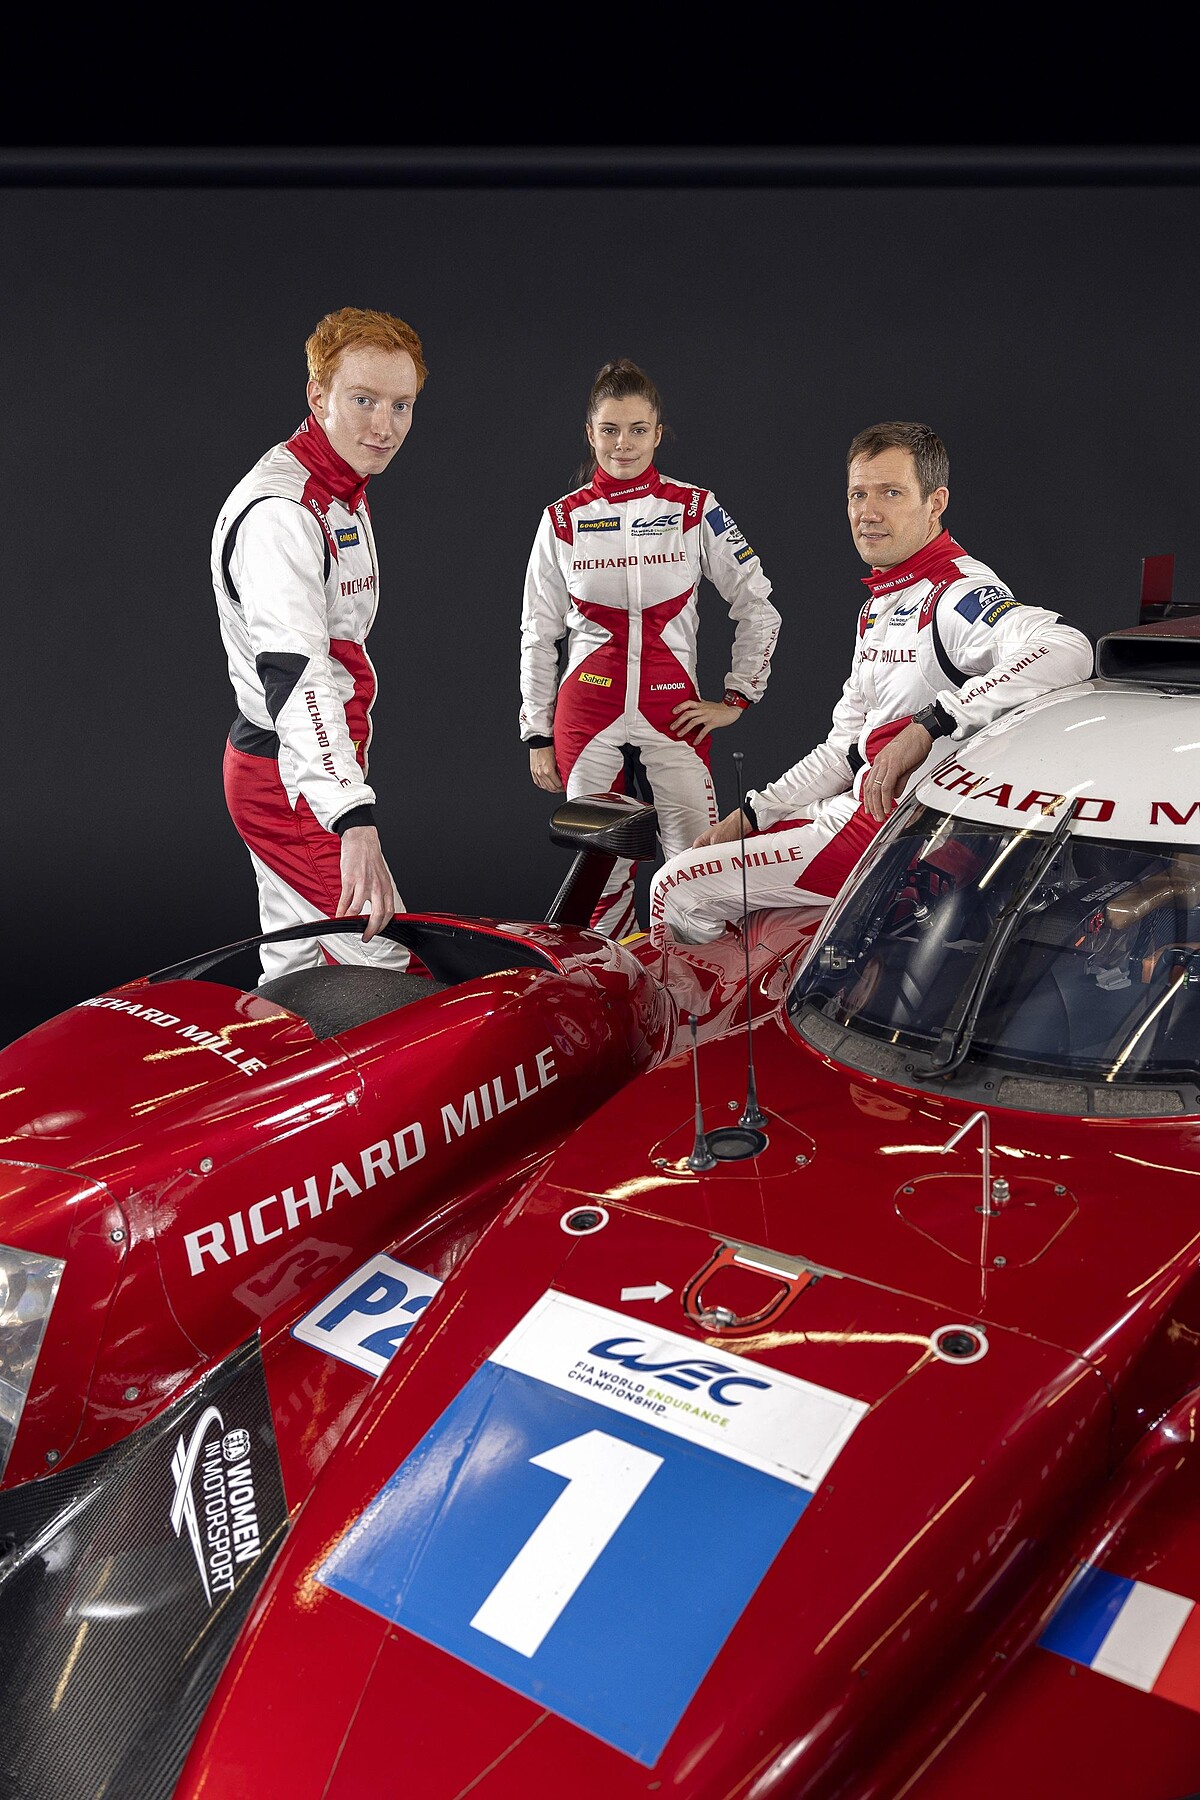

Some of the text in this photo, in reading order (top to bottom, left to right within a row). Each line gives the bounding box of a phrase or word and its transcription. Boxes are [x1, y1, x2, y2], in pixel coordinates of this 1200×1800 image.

[554, 503, 568, 529] Sabelt
[579, 521, 618, 529] GOODYEAR
[631, 513, 682, 528] WEC
[688, 490, 701, 518] Sabelt
[573, 551, 686, 571] RICHARD MILLE
[895, 573, 914, 585] MILLE
[582, 673, 609, 685] Sabelt
[1010, 646, 1050, 675] MILLE
[650, 681, 686, 691] L.WADOUX
[304, 690, 331, 748] RICHARD
[651, 846, 804, 921] RICHARD MILLE
[175, 1024, 268, 1077] MILLE
[183, 1121, 427, 1278] RICHARD
[440, 1045, 559, 1144] MILLE
[567, 1370, 667, 1414] CHAMPIONSHIP
[587, 1337, 772, 1407] WEC
[574, 1361, 731, 1428] FIA WORLD ENDURANCE
[202, 1440, 236, 1593] IN MOTORSPORT
[226, 1459, 262, 1564] WOMEN
[469, 1428, 666, 1659] 1
